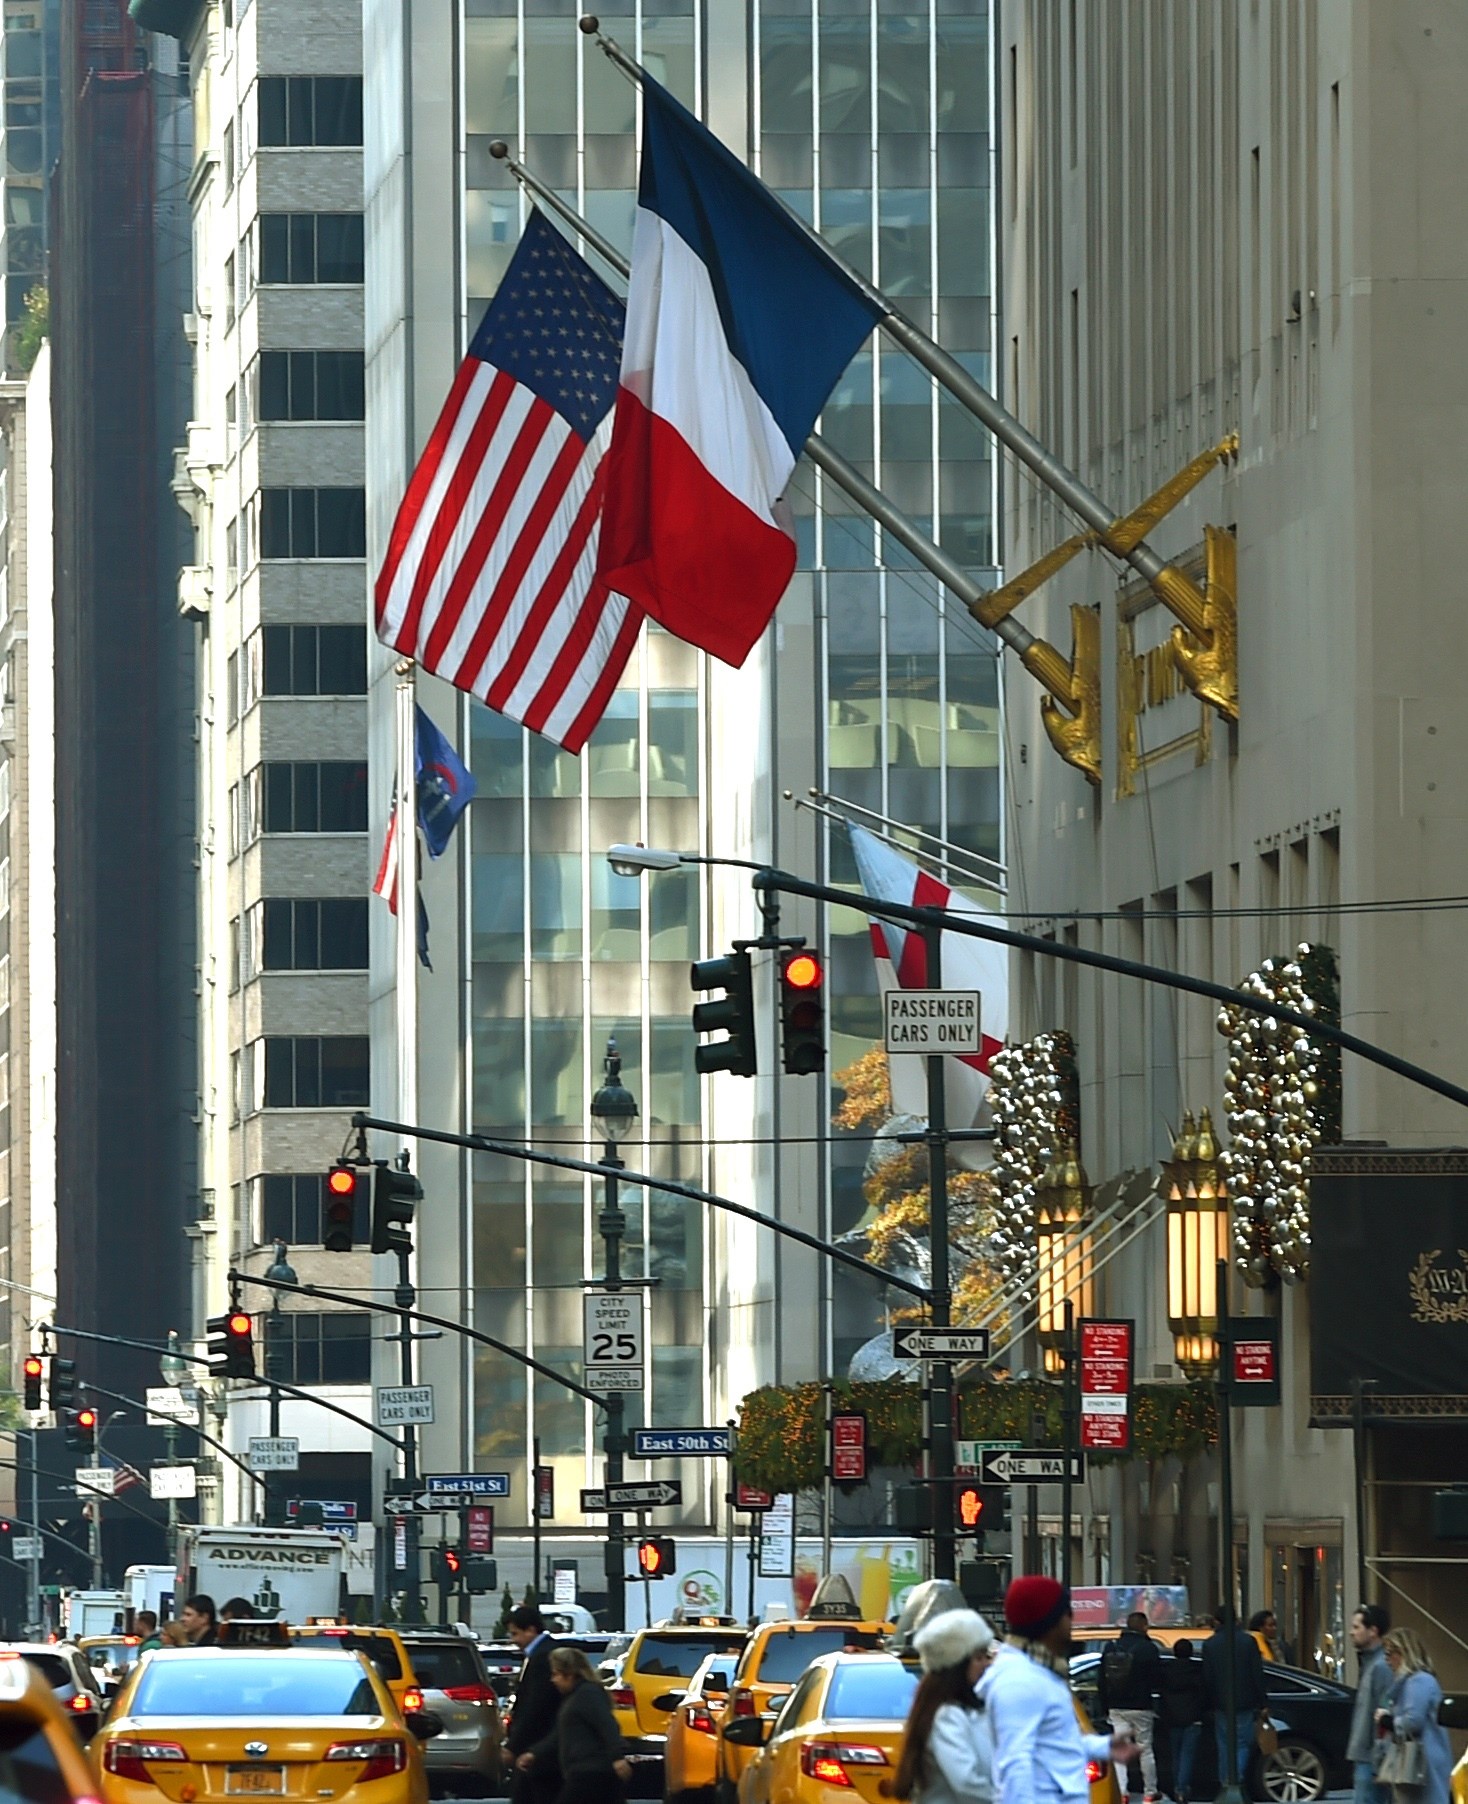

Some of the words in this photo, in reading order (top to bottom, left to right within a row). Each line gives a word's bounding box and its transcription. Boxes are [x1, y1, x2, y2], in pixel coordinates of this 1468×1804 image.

[891, 999, 975, 1018] PASSENGER
[891, 1024, 929, 1042] CARS
[938, 1024, 975, 1042] ONLY
[600, 1298, 626, 1307] CITY
[595, 1309, 631, 1318] SPEED
[599, 1320, 627, 1330] LIMIT
[1084, 1327, 1094, 1335] NO
[1096, 1327, 1126, 1336] STANDING
[592, 1333, 637, 1360] 25
[908, 1337, 935, 1350] ONE
[948, 1337, 977, 1350] WAY
[599, 1371, 630, 1379] PHOTO
[590, 1379, 640, 1388] ENFORCED
[381, 1390, 429, 1404] PASSENGER
[382, 1407, 404, 1419] CARS
[409, 1406, 430, 1418] ONLY
[252, 1441, 296, 1452] PASSENGER
[642, 1436, 674, 1450] East
[677, 1436, 709, 1450] 50th
[712, 1435, 729, 1450] St
[252, 1455, 271, 1465] CARS
[997, 1460, 1026, 1474] ONE
[1040, 1460, 1065, 1474] WA
[432, 1479, 459, 1491] East
[461, 1479, 486, 1492] 51st
[487, 1479, 502, 1492] St
[590, 1496, 605, 1506] ON
[615, 1489, 638, 1501] ONE
[647, 1488, 671, 1499] WAY
[209, 1548, 330, 1565] ADVANCE
[823, 1604, 848, 1615] 3Y35
[238, 1626, 271, 1641] 7F42
